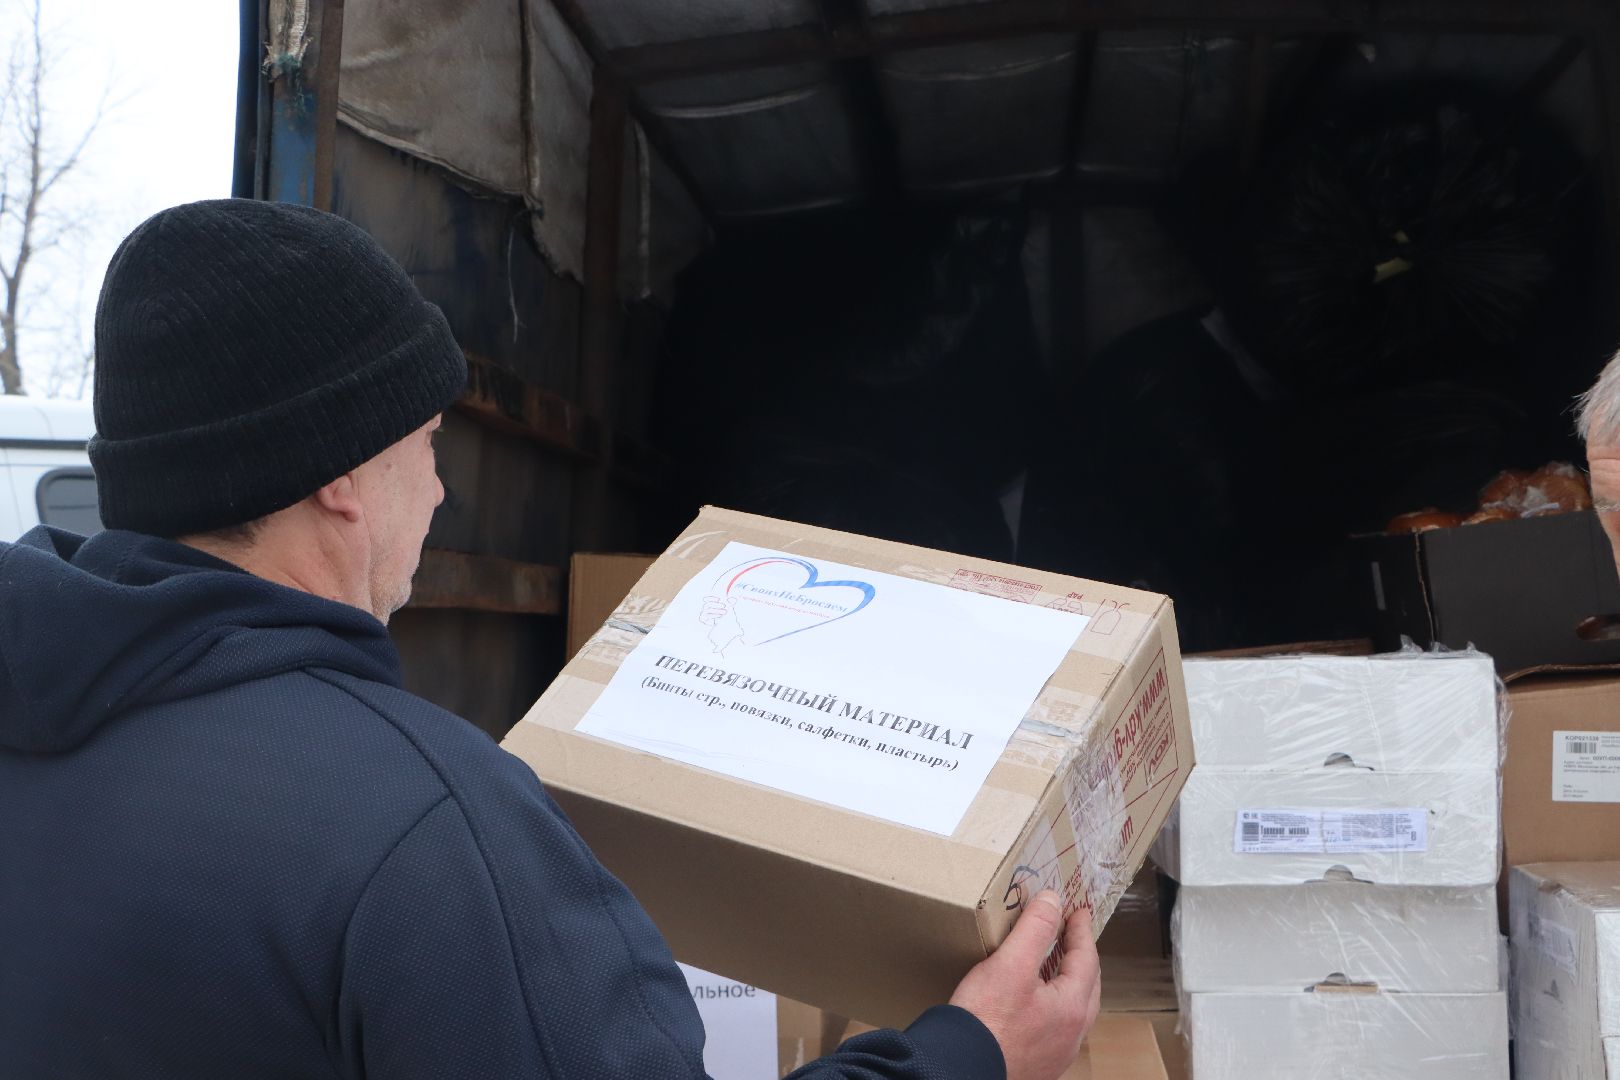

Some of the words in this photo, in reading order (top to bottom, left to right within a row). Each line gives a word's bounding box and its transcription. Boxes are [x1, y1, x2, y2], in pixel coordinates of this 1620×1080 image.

[736, 583, 848, 612] #СвоихНеБросаем
[641, 676, 694, 698] (Бинты
[695, 692, 726, 708] стр.,
[729, 701, 793, 729] повязки,
[797, 721, 872, 750] салфетки,
[875, 742, 959, 771] пластырь)
[655, 655, 837, 713] ПЕРЕВЯЗОЧНЫЙ
[838, 702, 974, 749] МАТЕРИАЛ
[693, 984, 756, 999] льное
